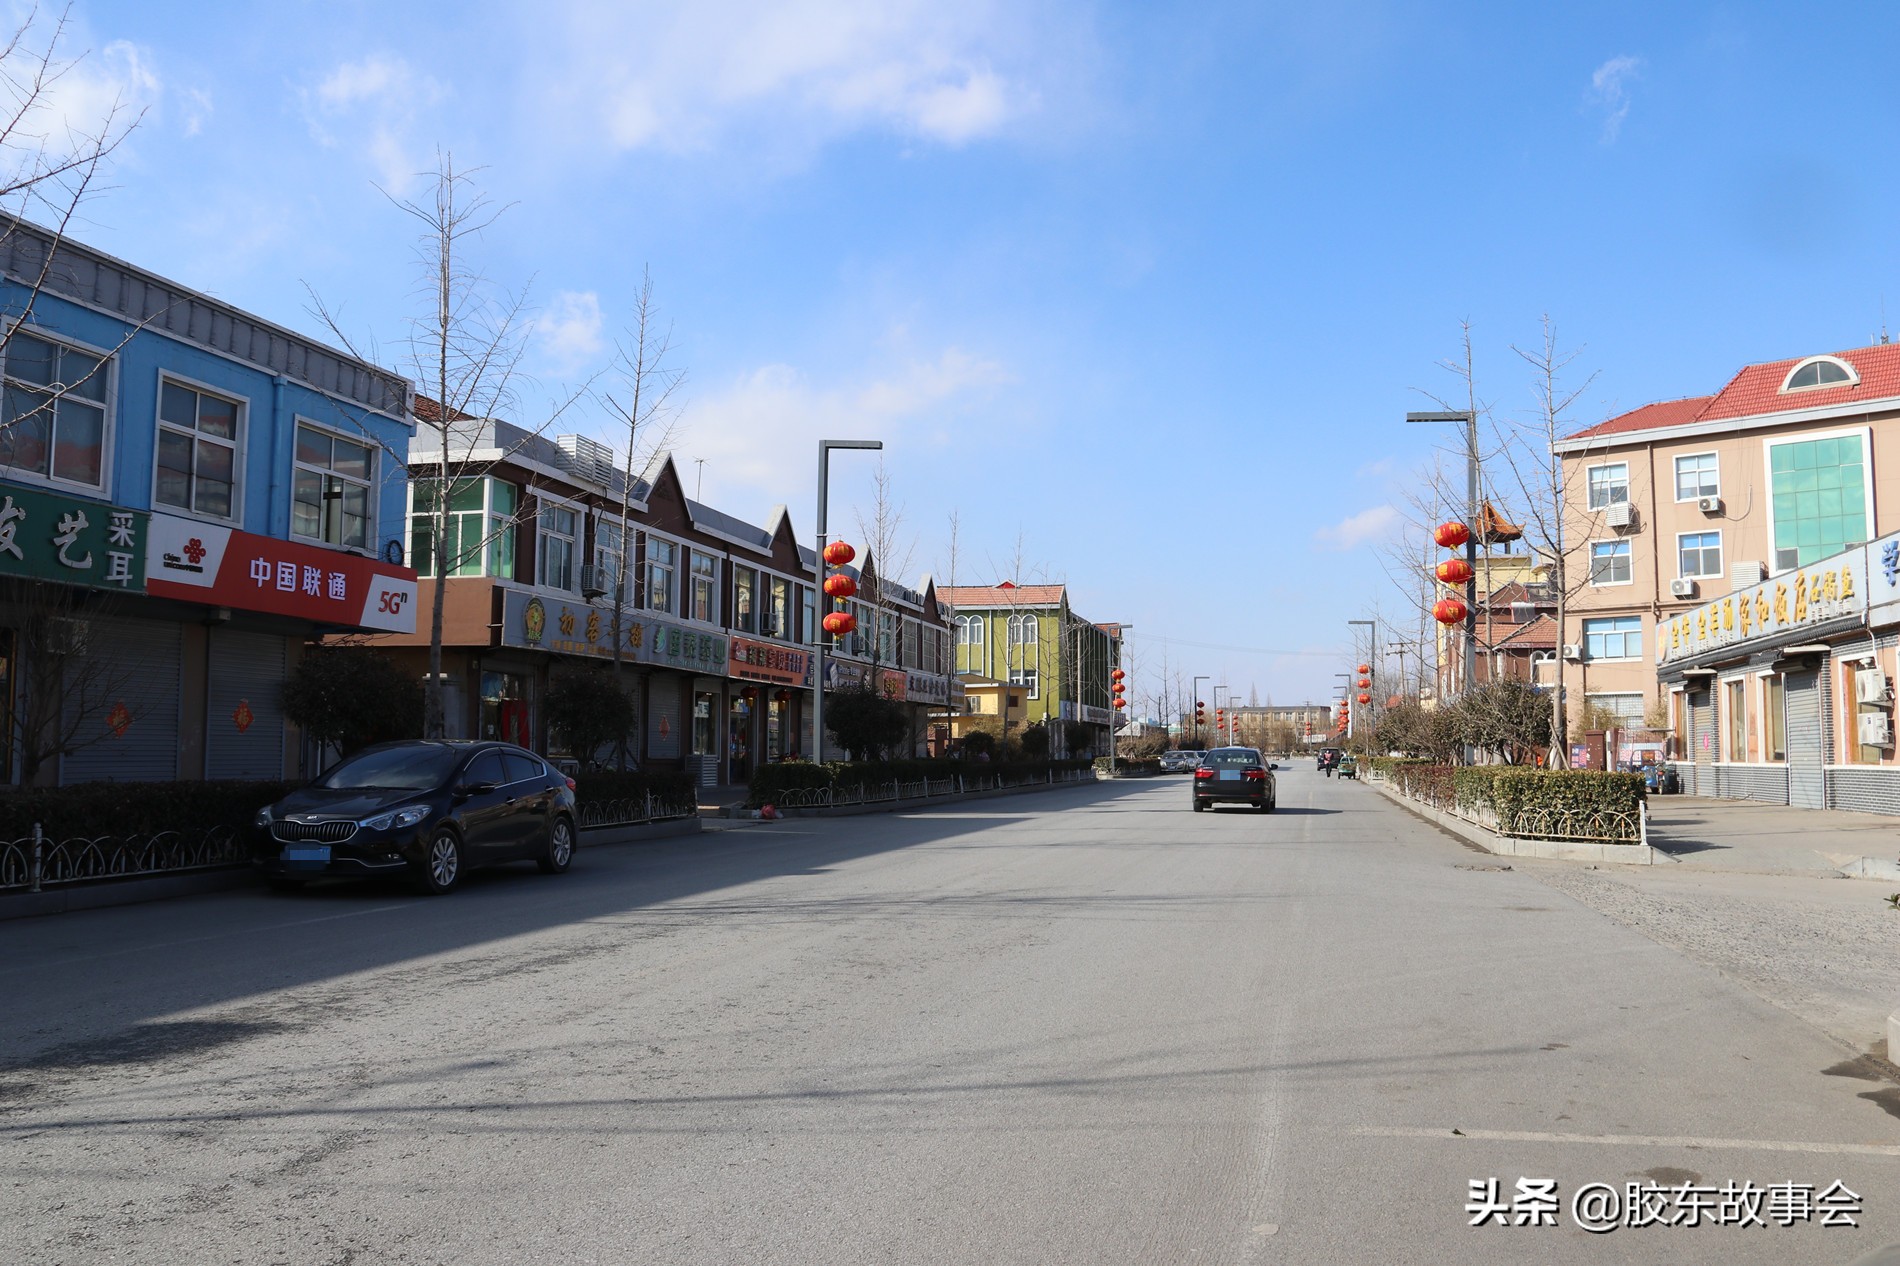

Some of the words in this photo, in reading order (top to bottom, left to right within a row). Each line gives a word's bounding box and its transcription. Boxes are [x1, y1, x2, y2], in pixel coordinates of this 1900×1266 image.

[107, 512, 135, 587] 采耳
[250, 557, 346, 601] 中国联通
